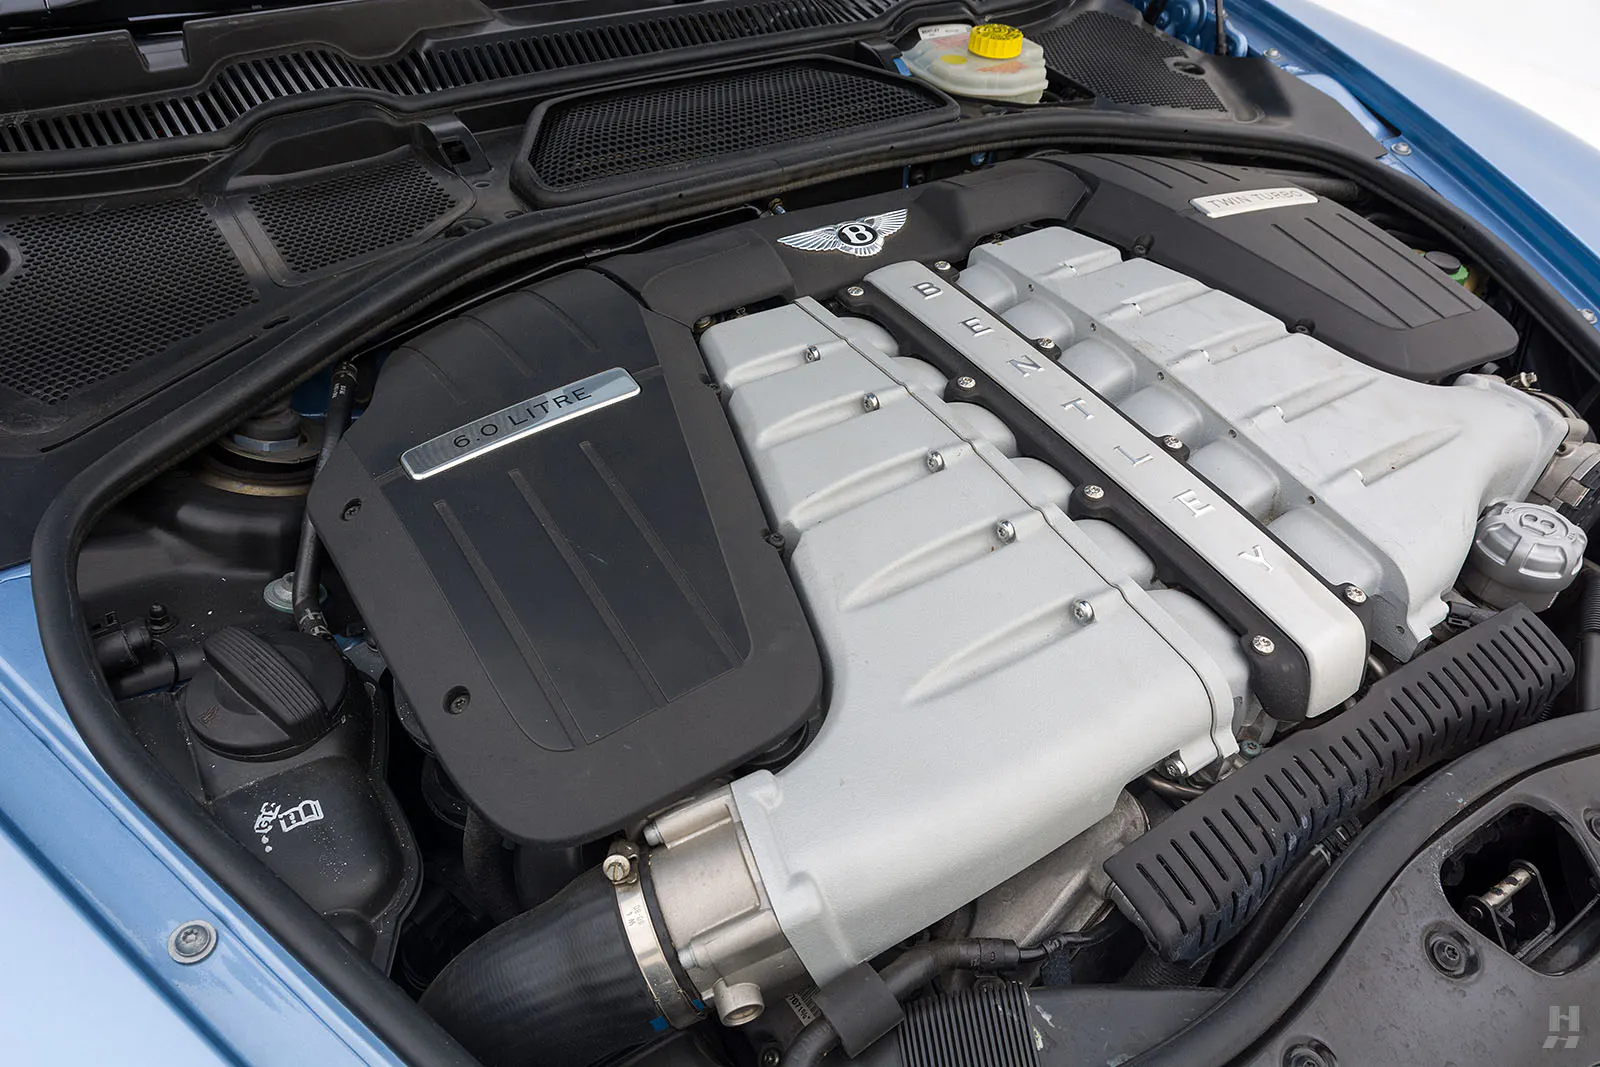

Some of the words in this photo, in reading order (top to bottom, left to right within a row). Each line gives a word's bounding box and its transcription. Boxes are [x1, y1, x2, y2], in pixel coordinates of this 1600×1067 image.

[1207, 193, 1252, 210] TWIN
[1251, 189, 1304, 202] TURBO
[841, 223, 874, 245] B
[453, 423, 498, 448] 6.0
[507, 387, 592, 426] LITRE
[911, 281, 1274, 573] BENTLEY
